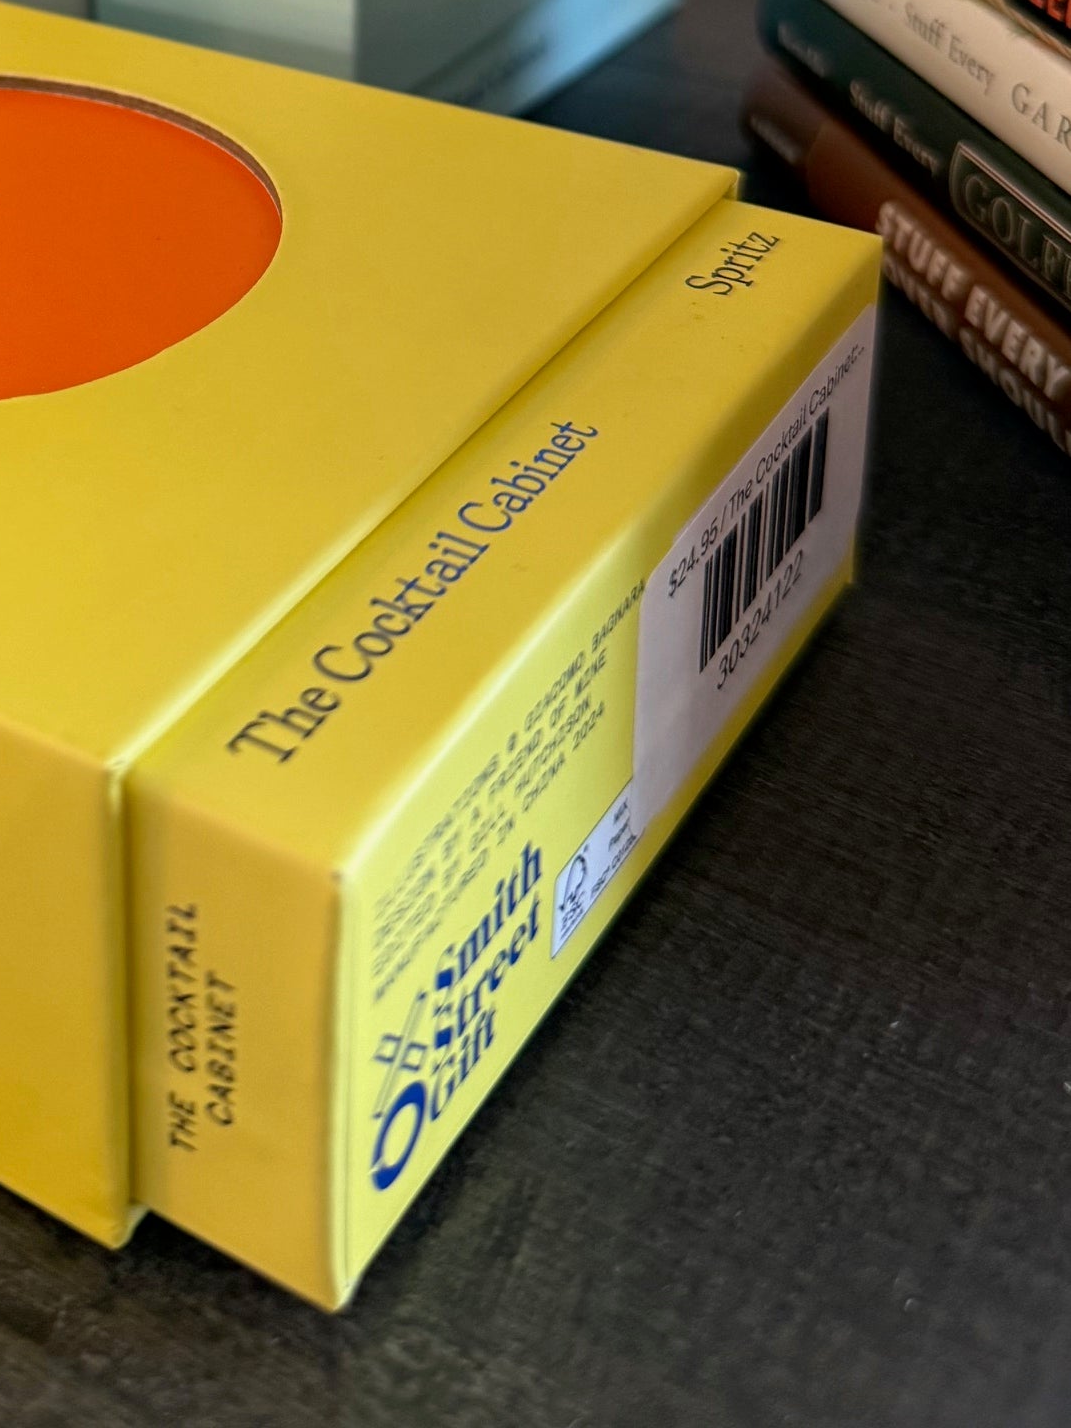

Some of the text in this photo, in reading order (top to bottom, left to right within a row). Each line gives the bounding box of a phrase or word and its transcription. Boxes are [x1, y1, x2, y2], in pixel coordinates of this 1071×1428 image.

[905, 2, 945, 51] Stuff
[948, 32, 993, 95] Every
[685, 229, 780, 297] Spritz
[877, 199, 1071, 404] STUFF EVERY
[963, 173, 1071, 298] GOLF
[669, 517, 719, 598] $24.95
[729, 481, 752, 518] The
[755, 406, 807, 484] Cocktail
[226, 419, 598, 763] The Cocktail Cabinet
[592, 579, 643, 650] BAGNARA
[717, 549, 804, 691] 30324122
[432, 891, 542, 1062] Street
[433, 840, 543, 1003] Smith
[166, 903, 199, 1153] THE COCKTAIL
[205, 969, 237, 1127] CABINET
[431, 1007, 497, 1122] Gift
